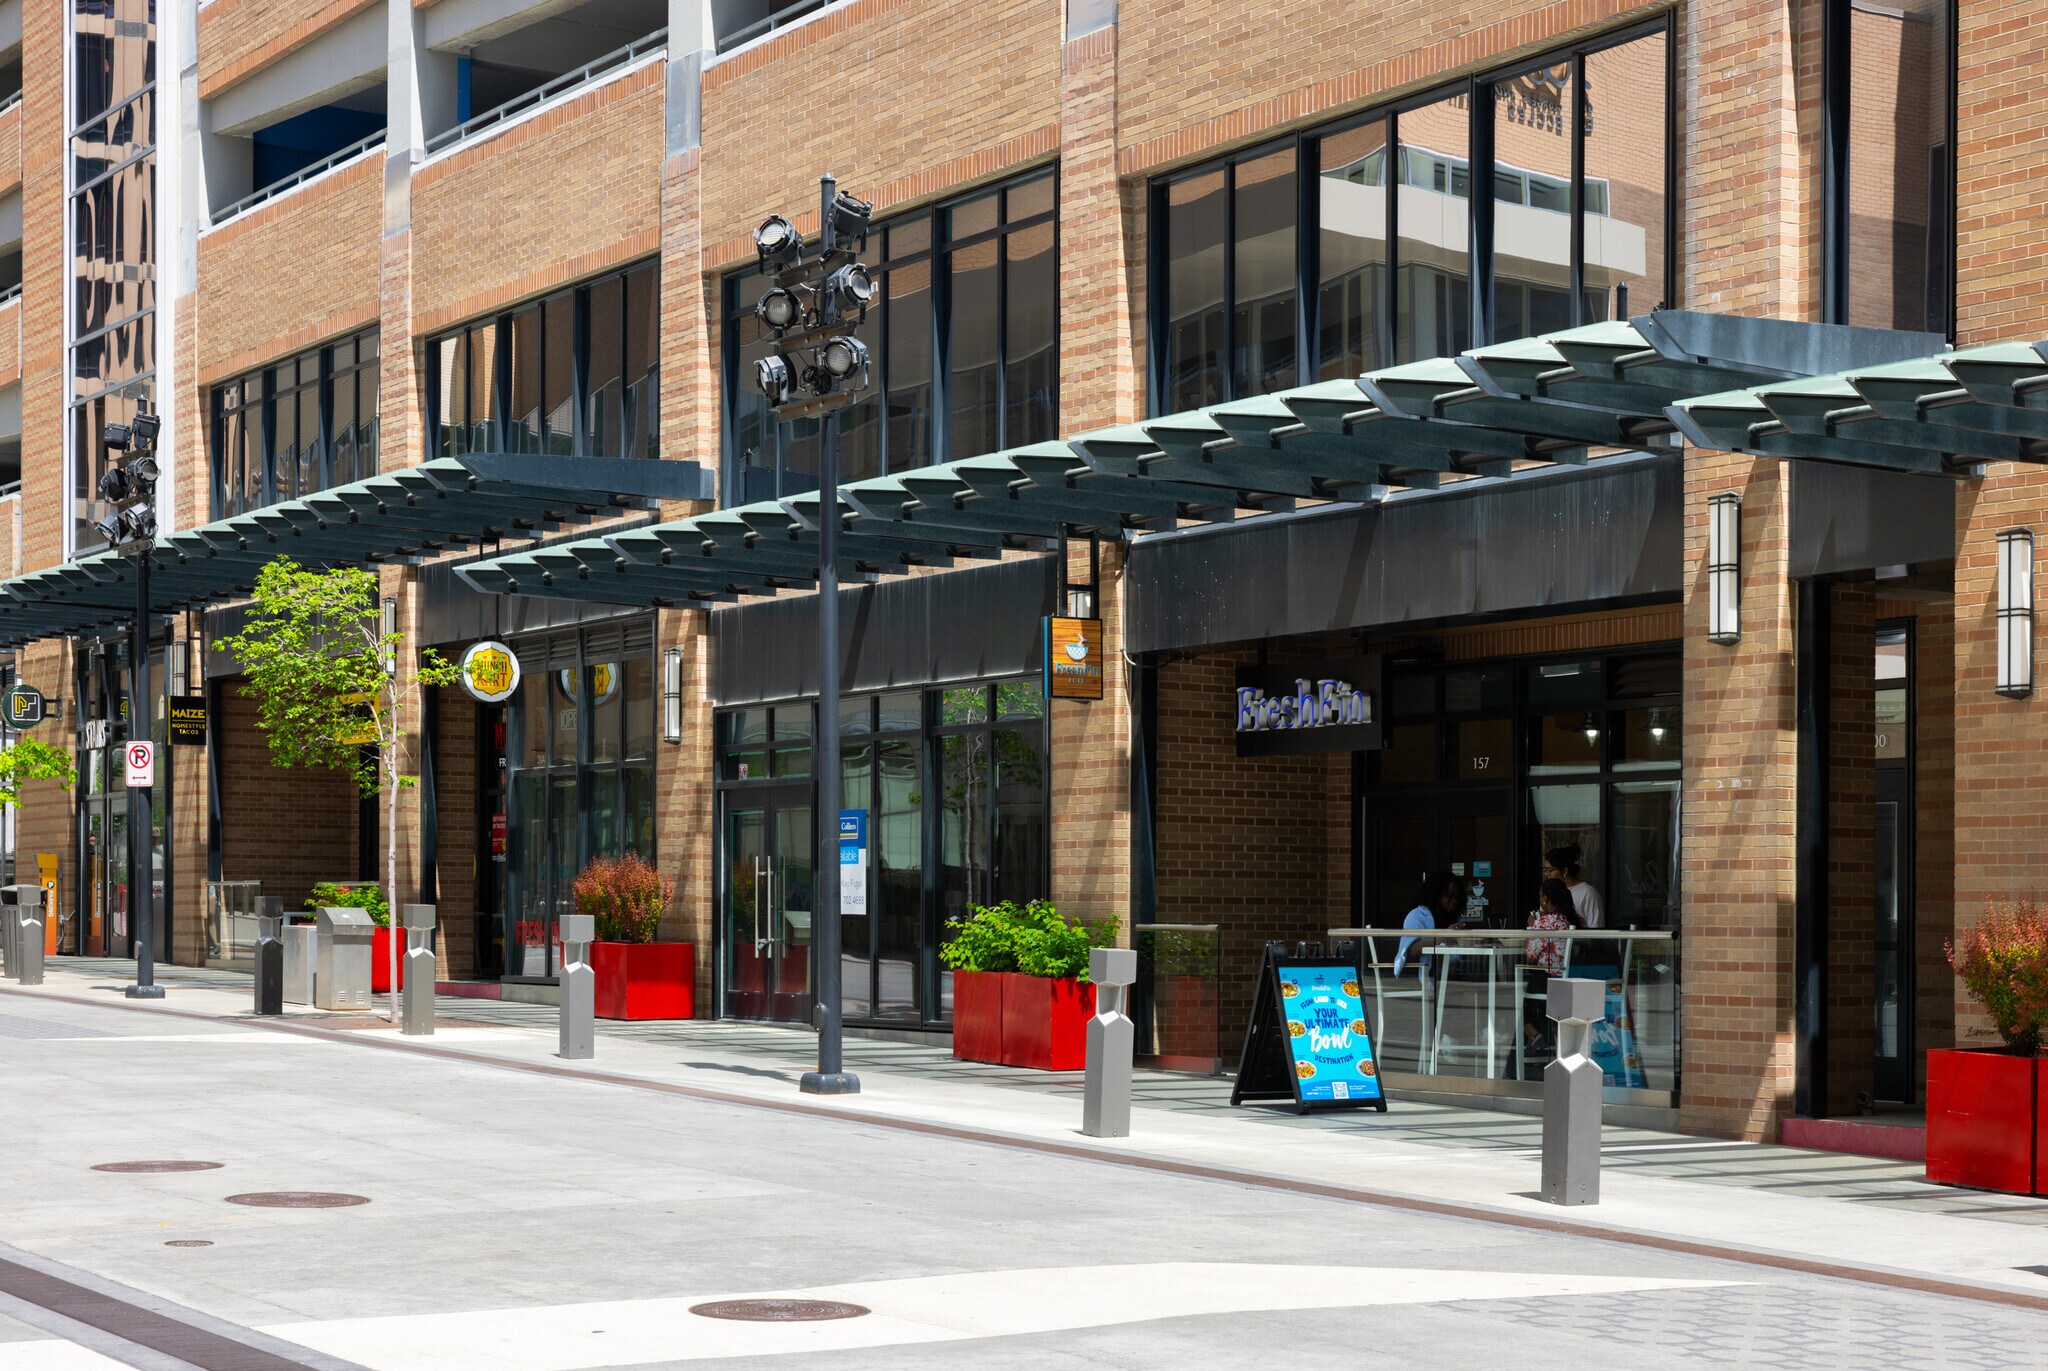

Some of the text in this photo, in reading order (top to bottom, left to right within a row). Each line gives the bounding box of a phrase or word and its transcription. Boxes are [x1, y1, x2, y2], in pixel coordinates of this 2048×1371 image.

[1056, 661, 1102, 676] FreshFin
[1236, 679, 1371, 731] FreshFin
[172, 708, 205, 718] MAIZE
[1473, 757, 1490, 769] 157
[1300, 998, 1314, 1009] FROM
[1313, 1008, 1338, 1018] YOUR
[1304, 1018, 1351, 1029] ULTIMATE
[1308, 1024, 1352, 1052] Bowl
[1314, 1053, 1354, 1064] DESTINATION
